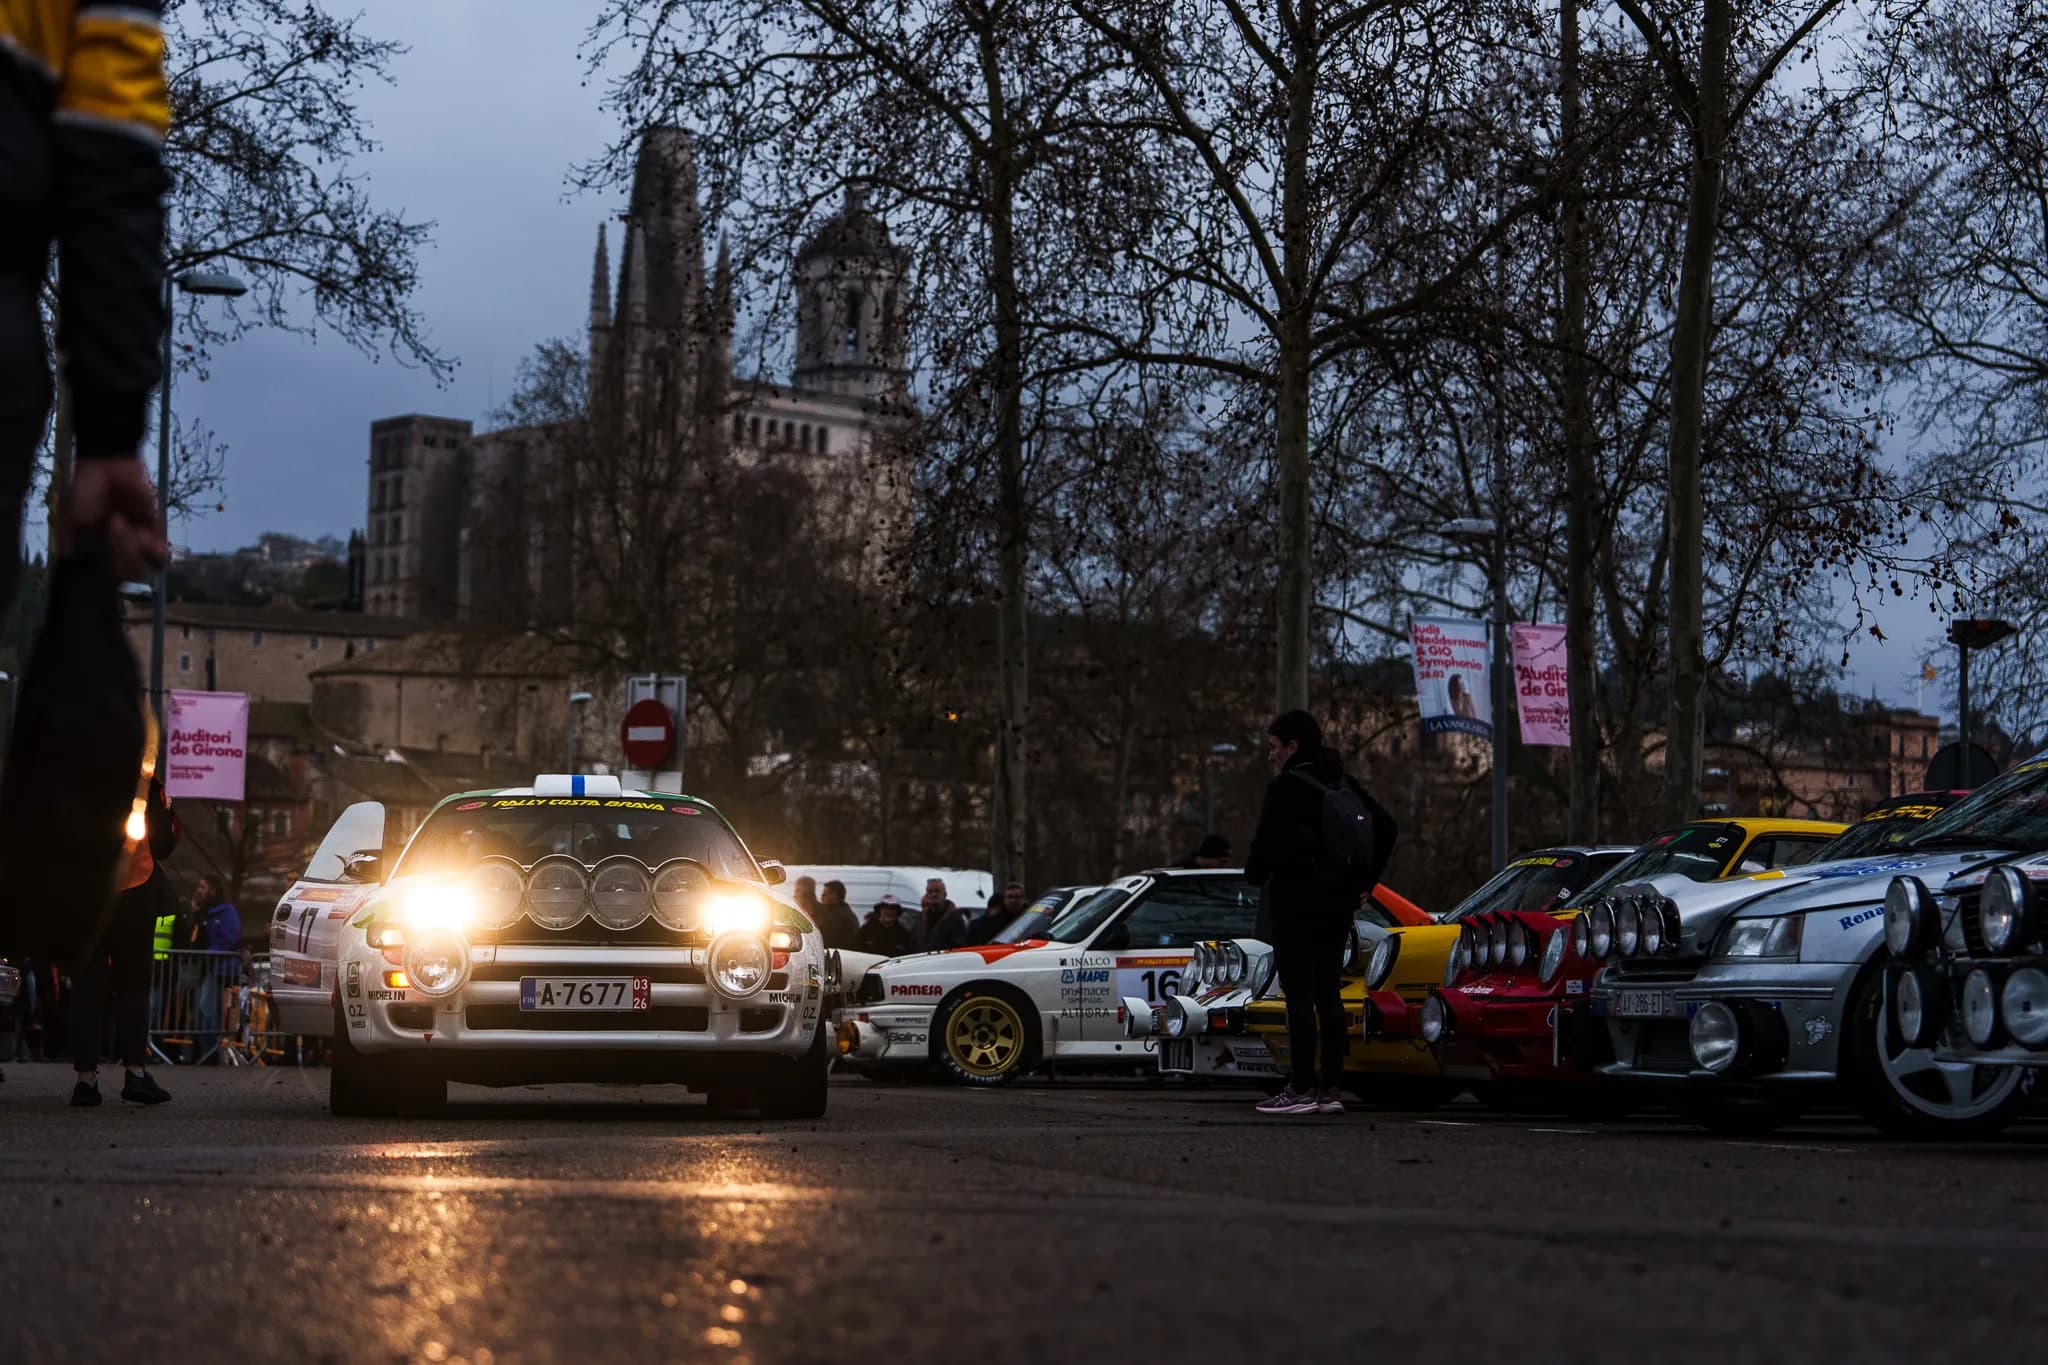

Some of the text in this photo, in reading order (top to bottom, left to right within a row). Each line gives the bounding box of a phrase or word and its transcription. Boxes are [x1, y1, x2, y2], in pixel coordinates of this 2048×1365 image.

[1414, 624, 1440, 634] Judit
[1429, 645, 1452, 656] GIO
[1520, 665, 1567, 681] Audito
[1521, 681, 1568, 697] de Gir
[171, 729, 231, 744] Auditori
[171, 742, 243, 758] de Girona
[492, 799, 547, 808] RALLY
[604, 800, 665, 811] BRAVA
[1838, 906, 1884, 930] Rena
[297, 906, 320, 954] 17
[1071, 957, 1111, 967] INALCO
[1076, 971, 1110, 982] MAPEI
[633, 979, 648, 990] 03
[891, 985, 943, 996] PAMESA
[1141, 970, 1182, 1002] 16
[368, 990, 406, 1001] MICHELIN
[541, 983, 627, 1005] A-7677
[633, 998, 647, 1009] 26
